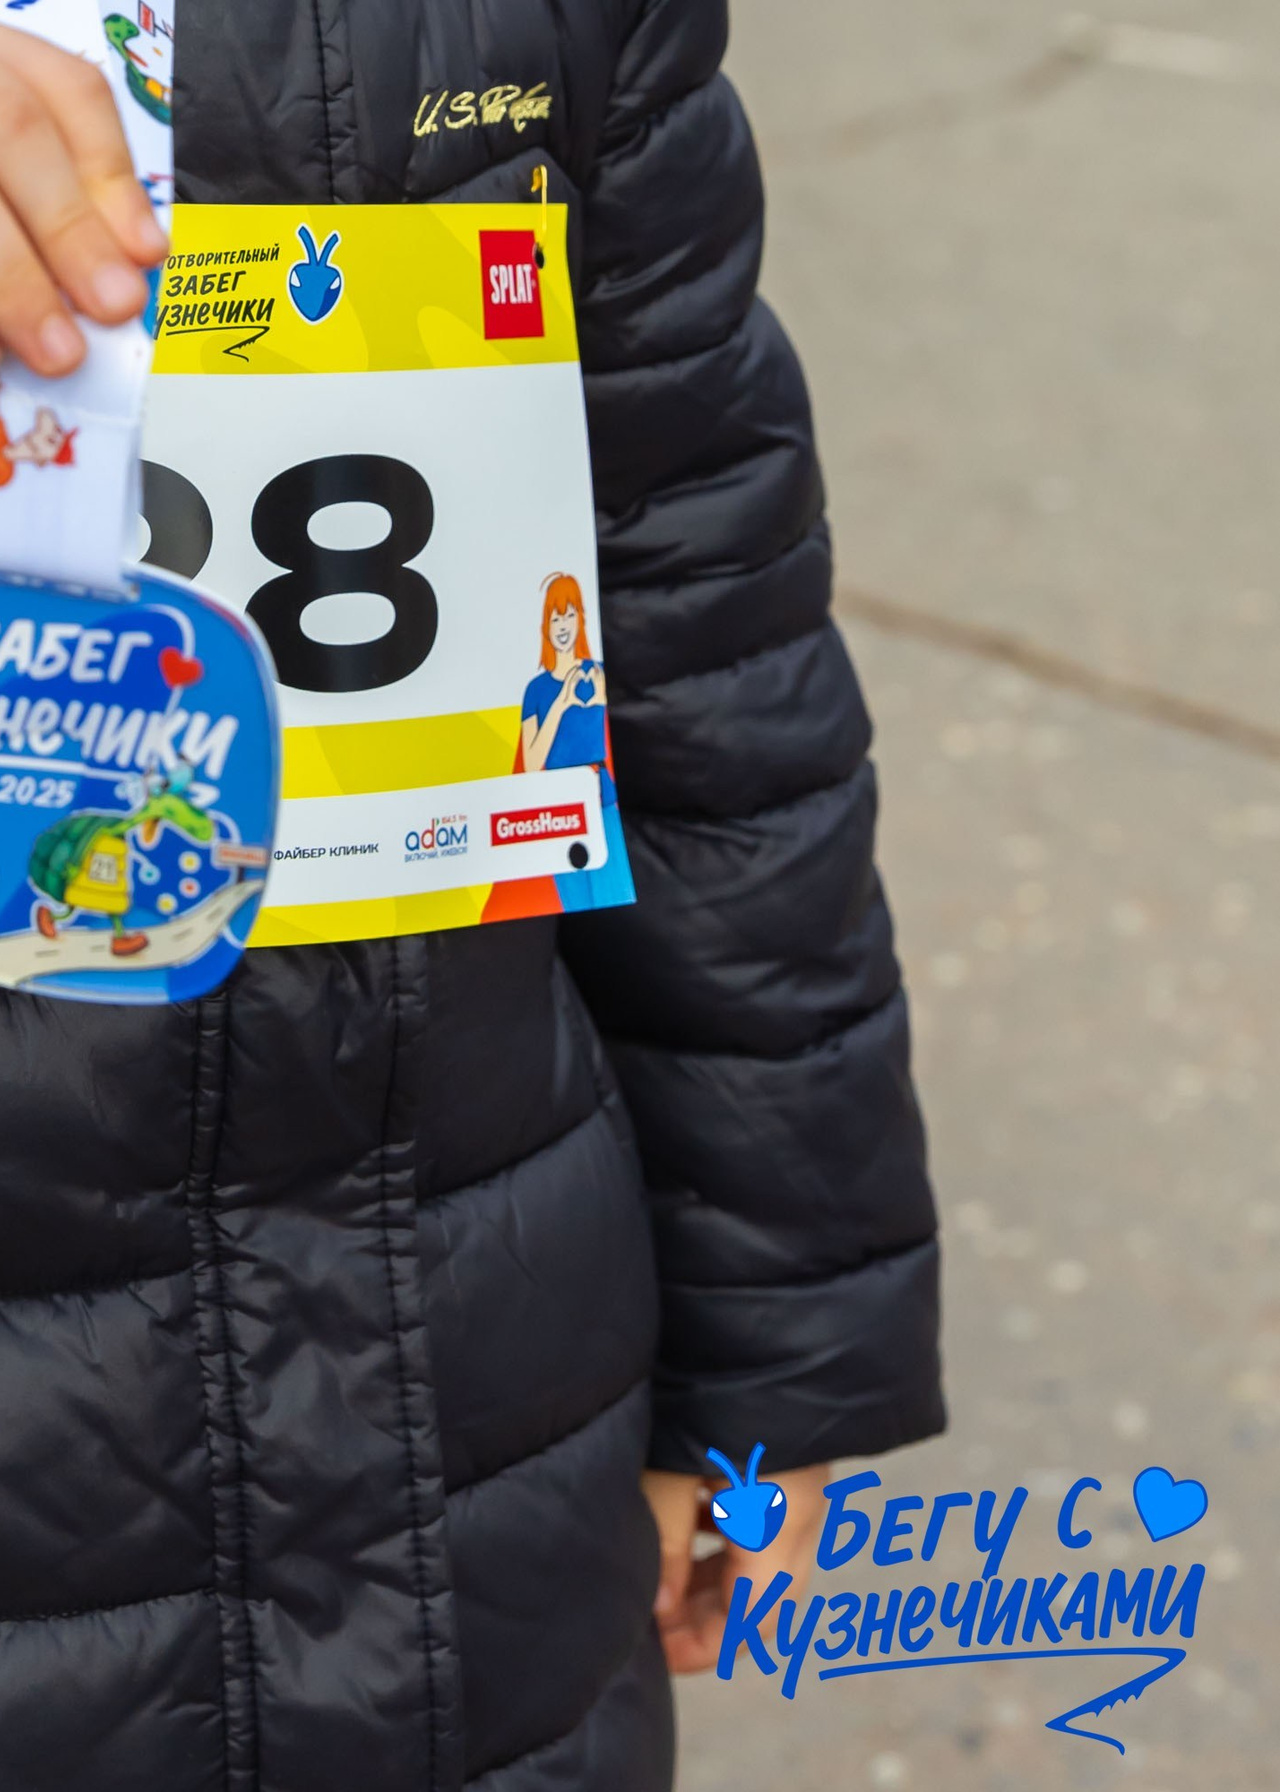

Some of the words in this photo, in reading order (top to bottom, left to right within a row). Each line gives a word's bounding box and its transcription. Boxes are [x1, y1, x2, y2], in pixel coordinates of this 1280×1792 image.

[162, 242, 280, 270] ОТВОРИТЕЛЬНЫЙ
[165, 270, 247, 298] ЗАБЕГ
[488, 263, 534, 305] SPLAT
[496, 811, 581, 840] GrossHaus
[273, 846, 326, 861] ФАЙБЕР
[329, 843, 380, 857] КЛИНИК
